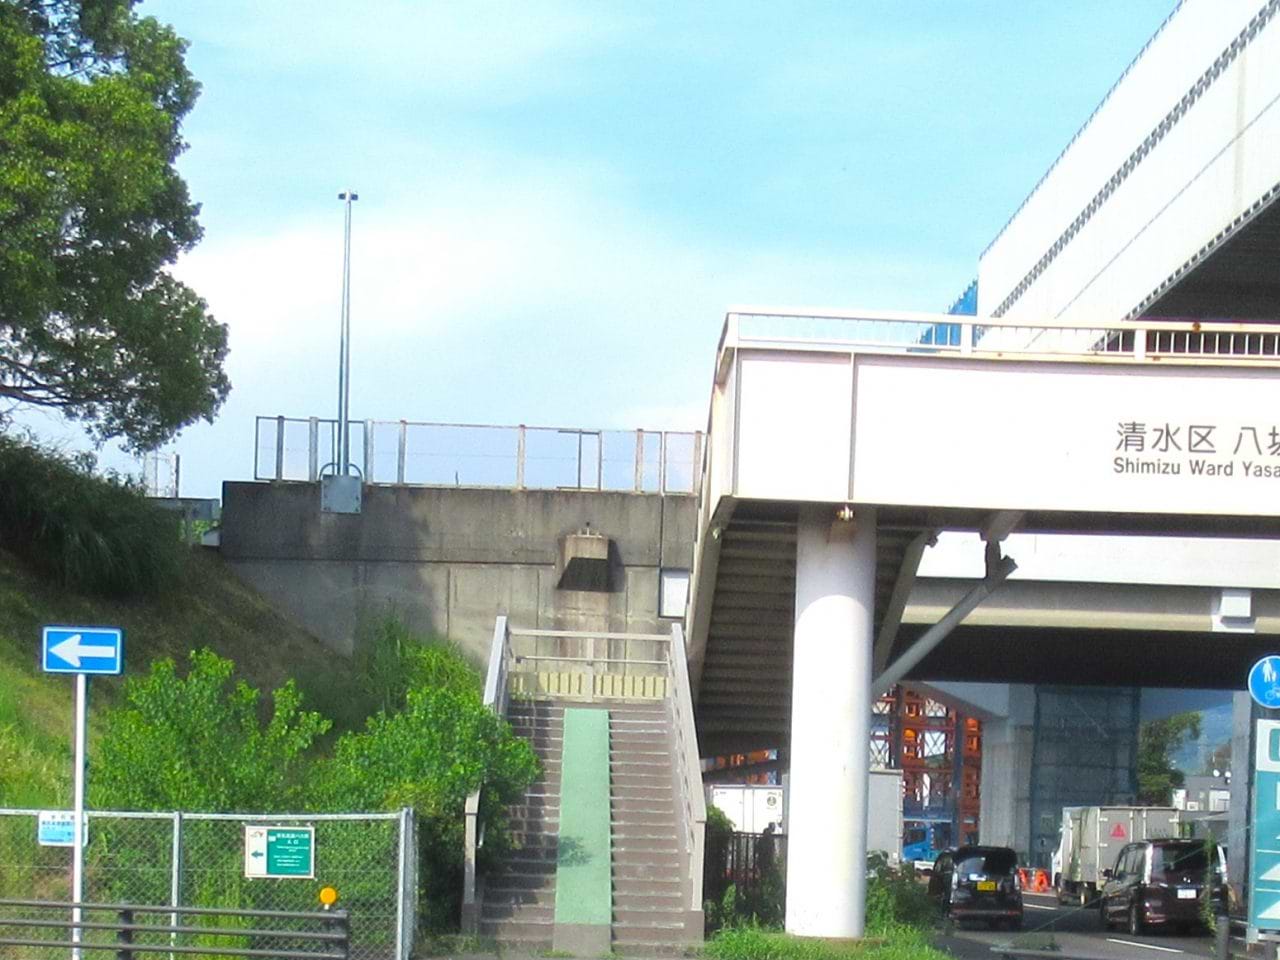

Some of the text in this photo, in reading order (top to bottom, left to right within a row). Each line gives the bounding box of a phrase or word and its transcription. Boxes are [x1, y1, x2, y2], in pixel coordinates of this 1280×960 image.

[1116, 421, 1217, 453] 清水区
[1113, 457, 1181, 475] Shimizu
[1189, 459, 1233, 477] Ward
